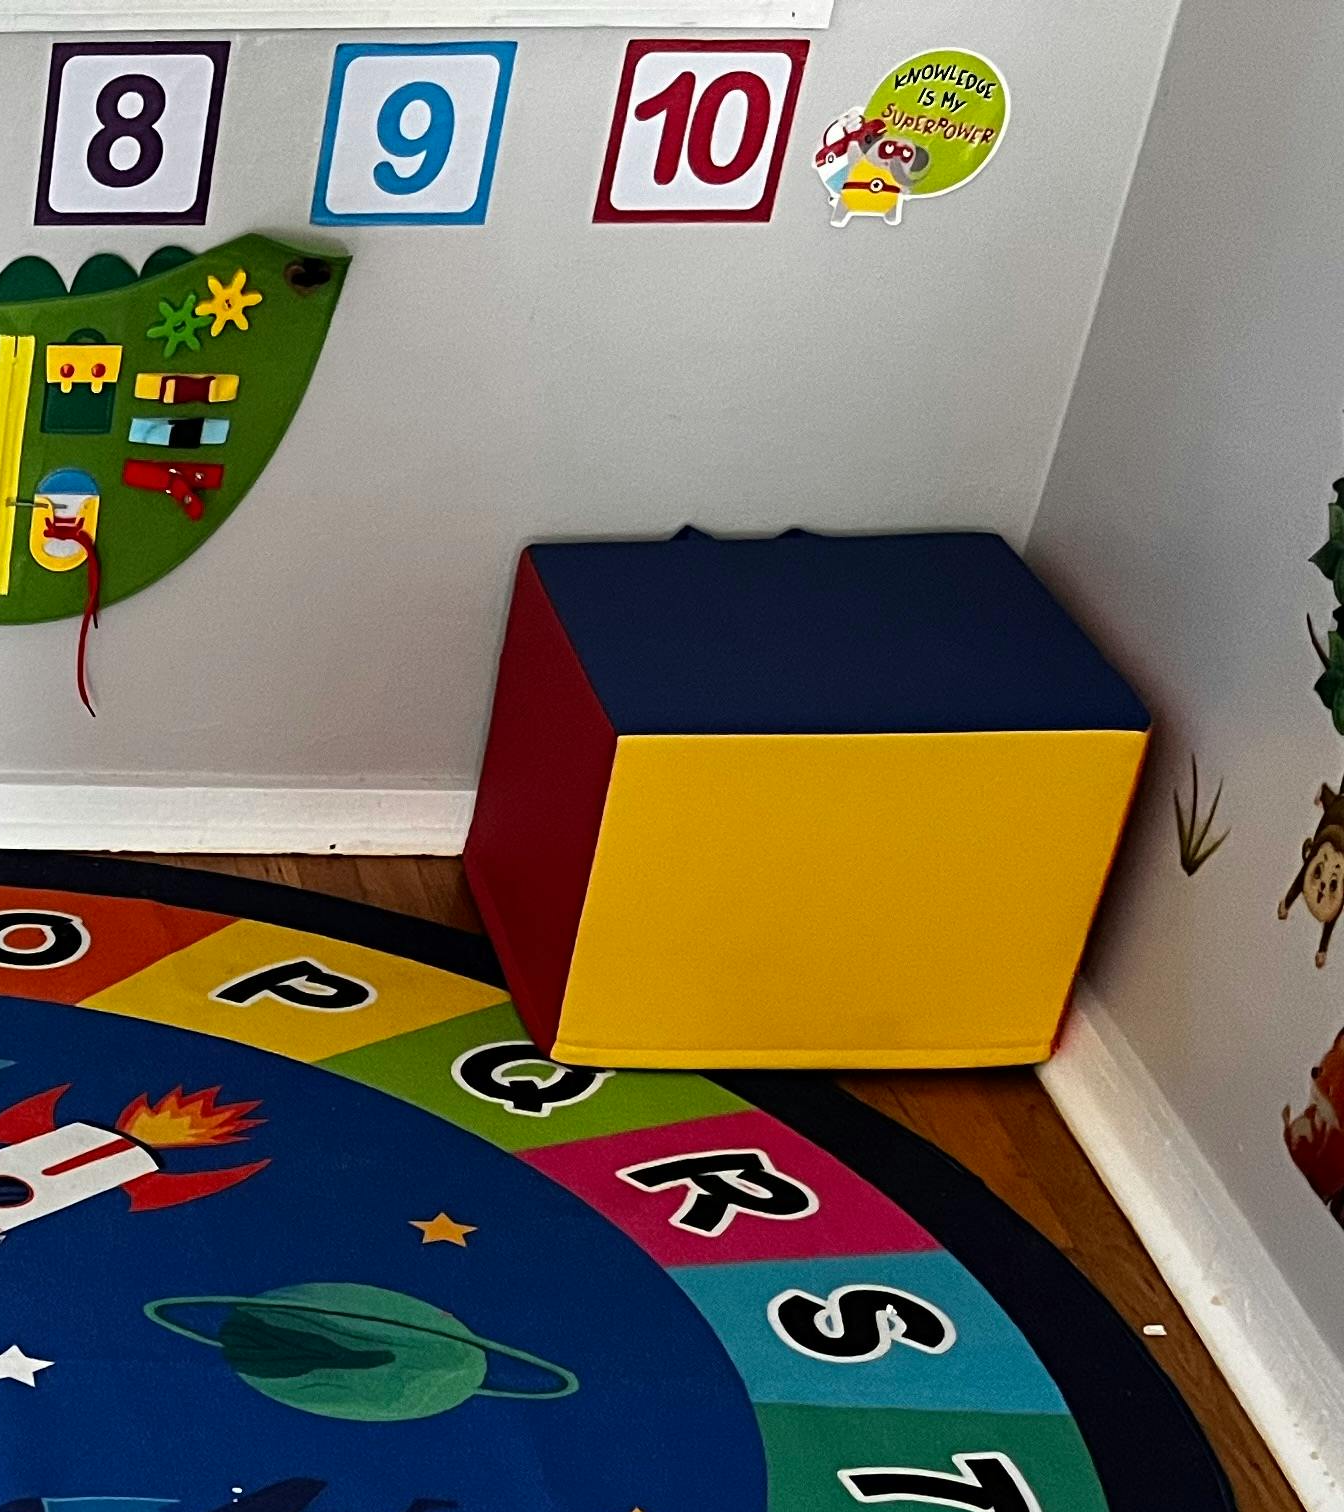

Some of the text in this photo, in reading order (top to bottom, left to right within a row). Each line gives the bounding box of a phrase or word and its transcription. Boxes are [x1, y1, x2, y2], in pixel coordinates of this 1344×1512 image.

[894, 64, 995, 98] KNOWLEDGE
[917, 88, 935, 106] IS
[85, 73, 168, 189] 8
[372, 81, 455, 195] 9
[634, 70, 772, 186] 10
[882, 103, 995, 144] SUPERPOWER
[211, 957, 378, 1015] P
[450, 1040, 617, 1117] Q
[615, 1147, 820, 1238] R
[766, 1284, 958, 1364] S
